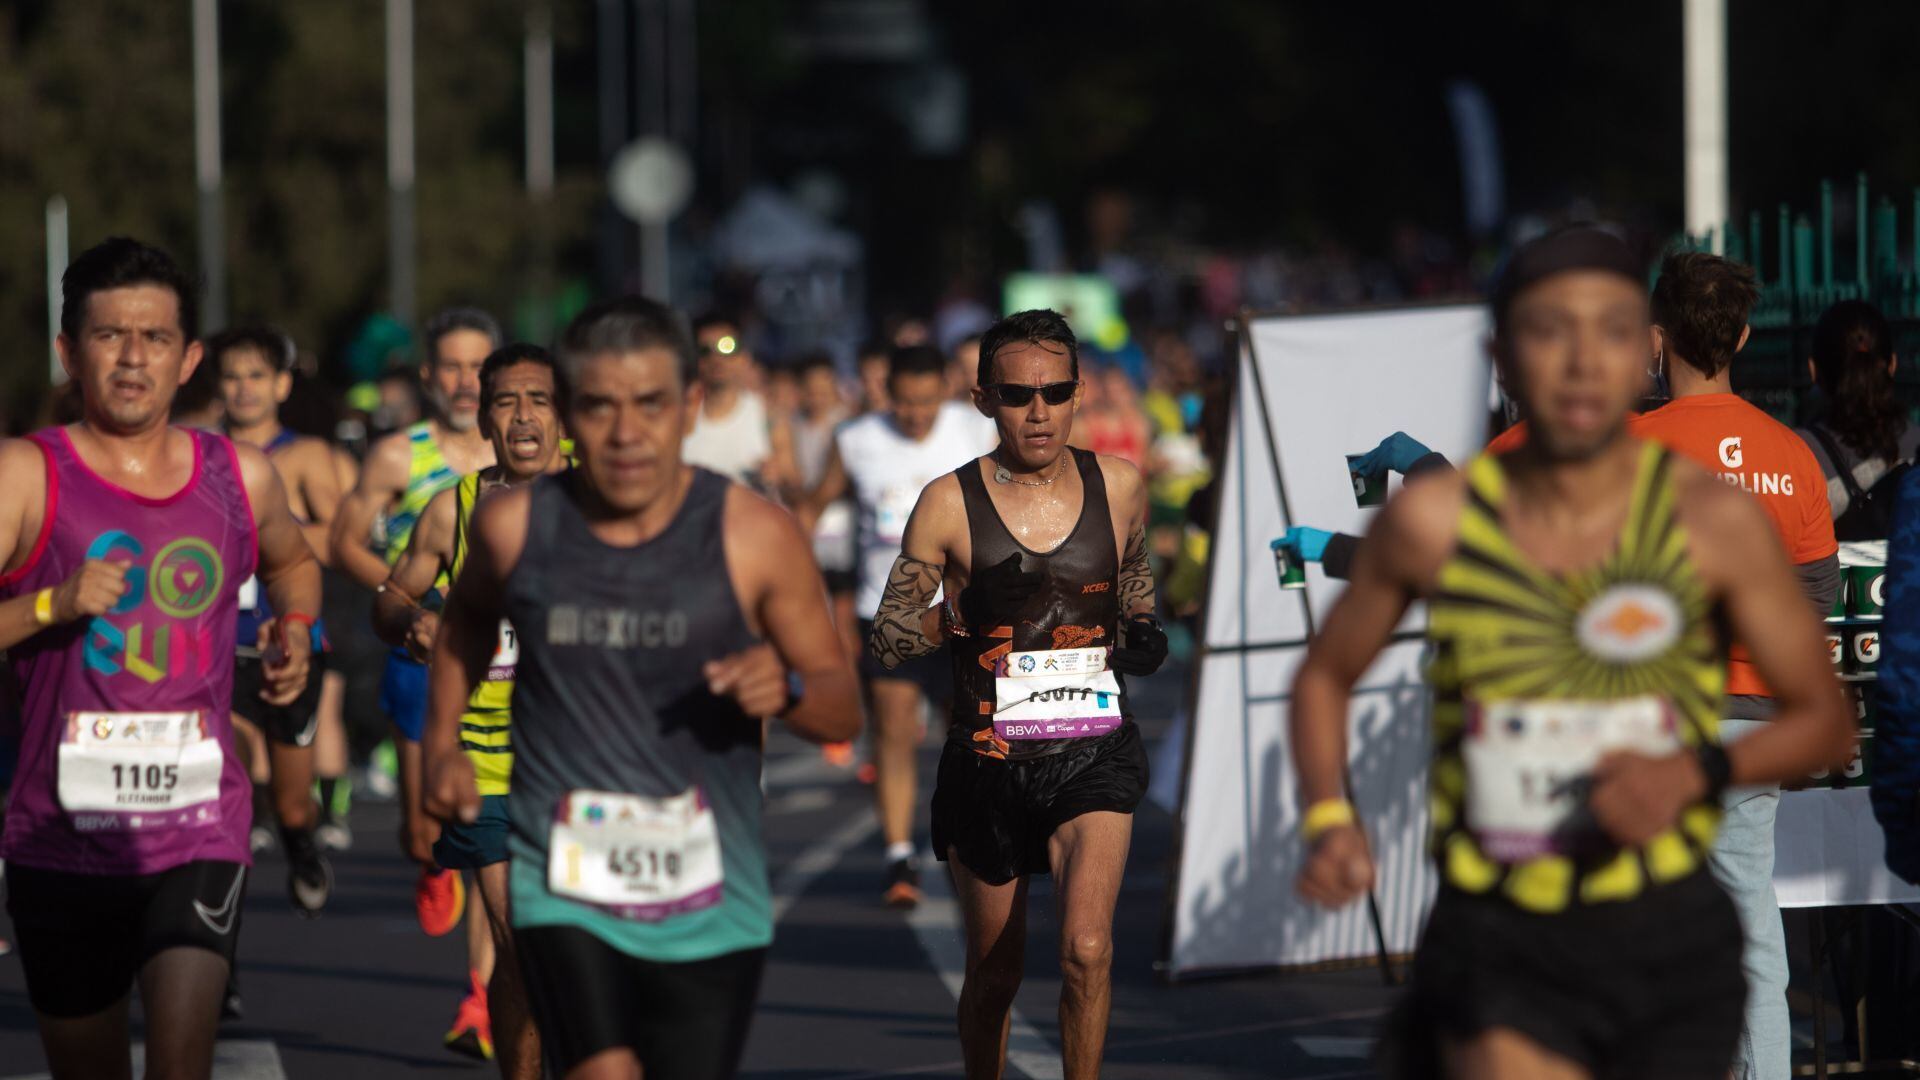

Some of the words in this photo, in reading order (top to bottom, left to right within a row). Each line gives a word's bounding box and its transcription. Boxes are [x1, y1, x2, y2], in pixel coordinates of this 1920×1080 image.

[1854, 632, 1880, 664] G
[1006, 724, 1042, 736] BBVA
[112, 763, 179, 790] 1105
[74, 814, 120, 830] BBVA
